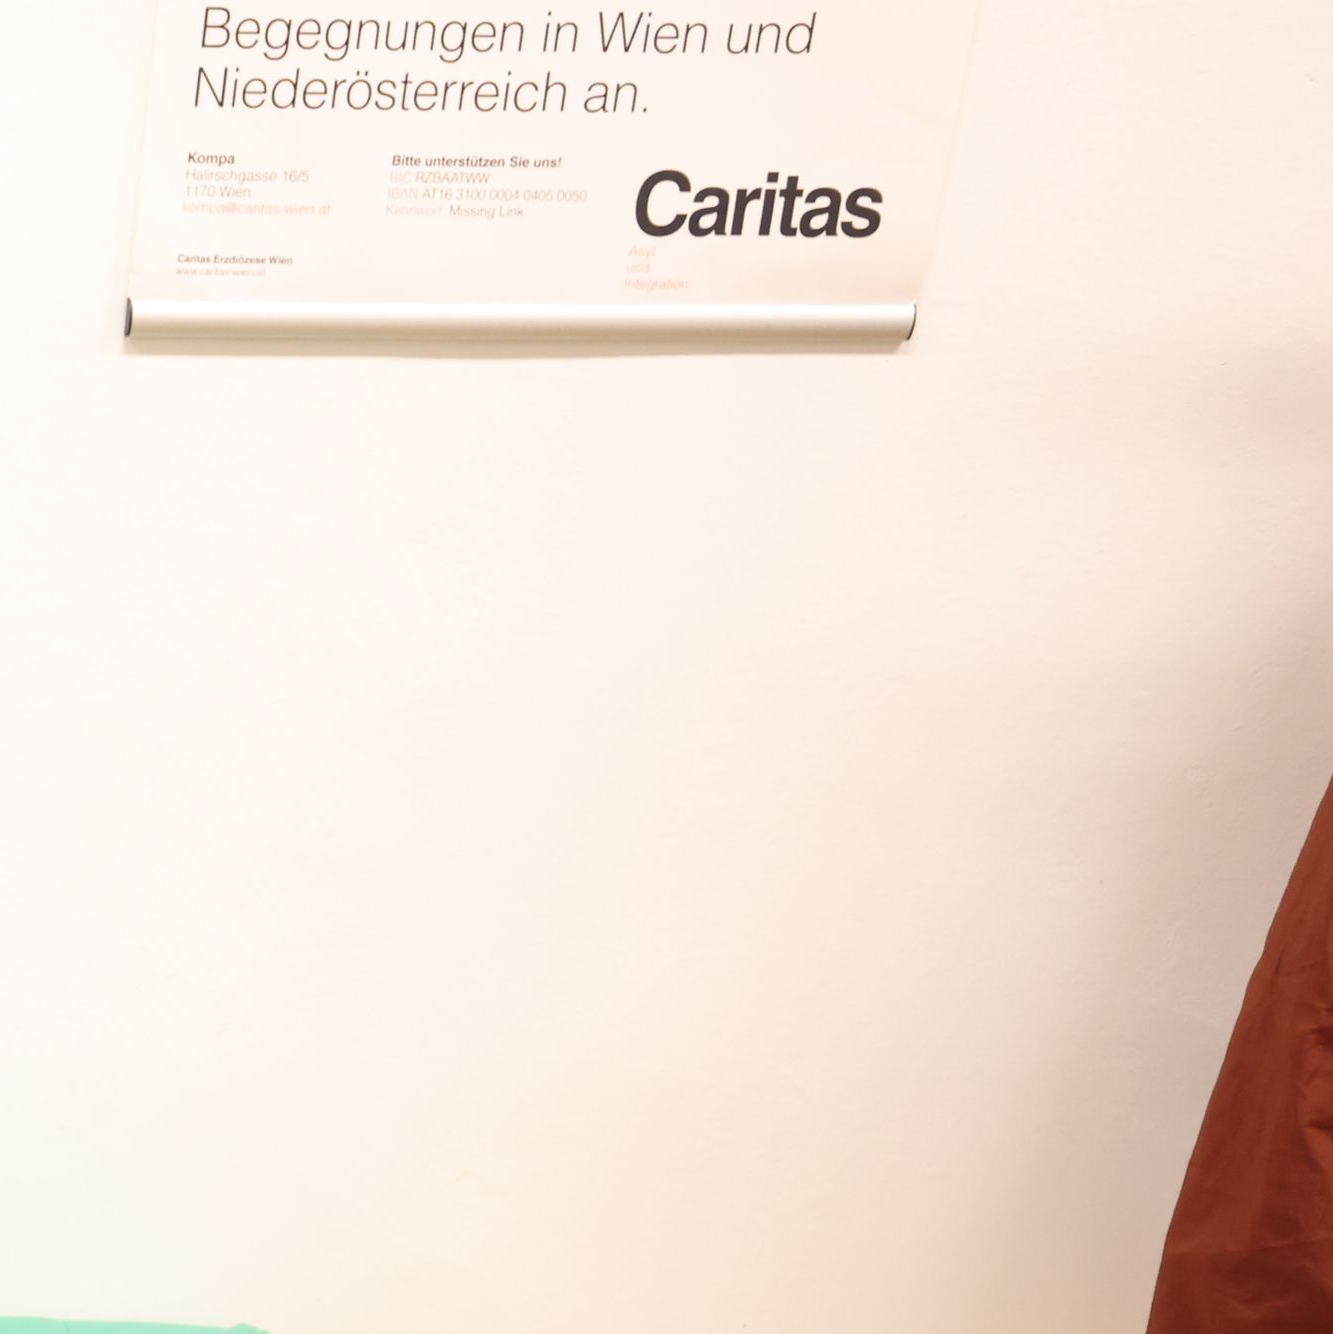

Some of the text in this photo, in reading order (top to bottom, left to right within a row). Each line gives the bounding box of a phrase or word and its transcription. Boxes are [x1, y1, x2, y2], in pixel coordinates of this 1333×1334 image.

[200, 6, 817, 63] Begegnungen in Wien und
[193, 66, 649, 113] Niederösterreich an.
[187, 151, 236, 167] Kompa
[391, 154, 563, 169] Bitte unterstützen Sie uns!
[185, 185, 252, 198] 1170 Wien
[388, 187, 420, 200] IBAN
[635, 169, 883, 238] Caritas
[448, 204, 495, 220] Missing
[499, 205, 525, 218] Link
[269, 255, 294, 265] Wien
